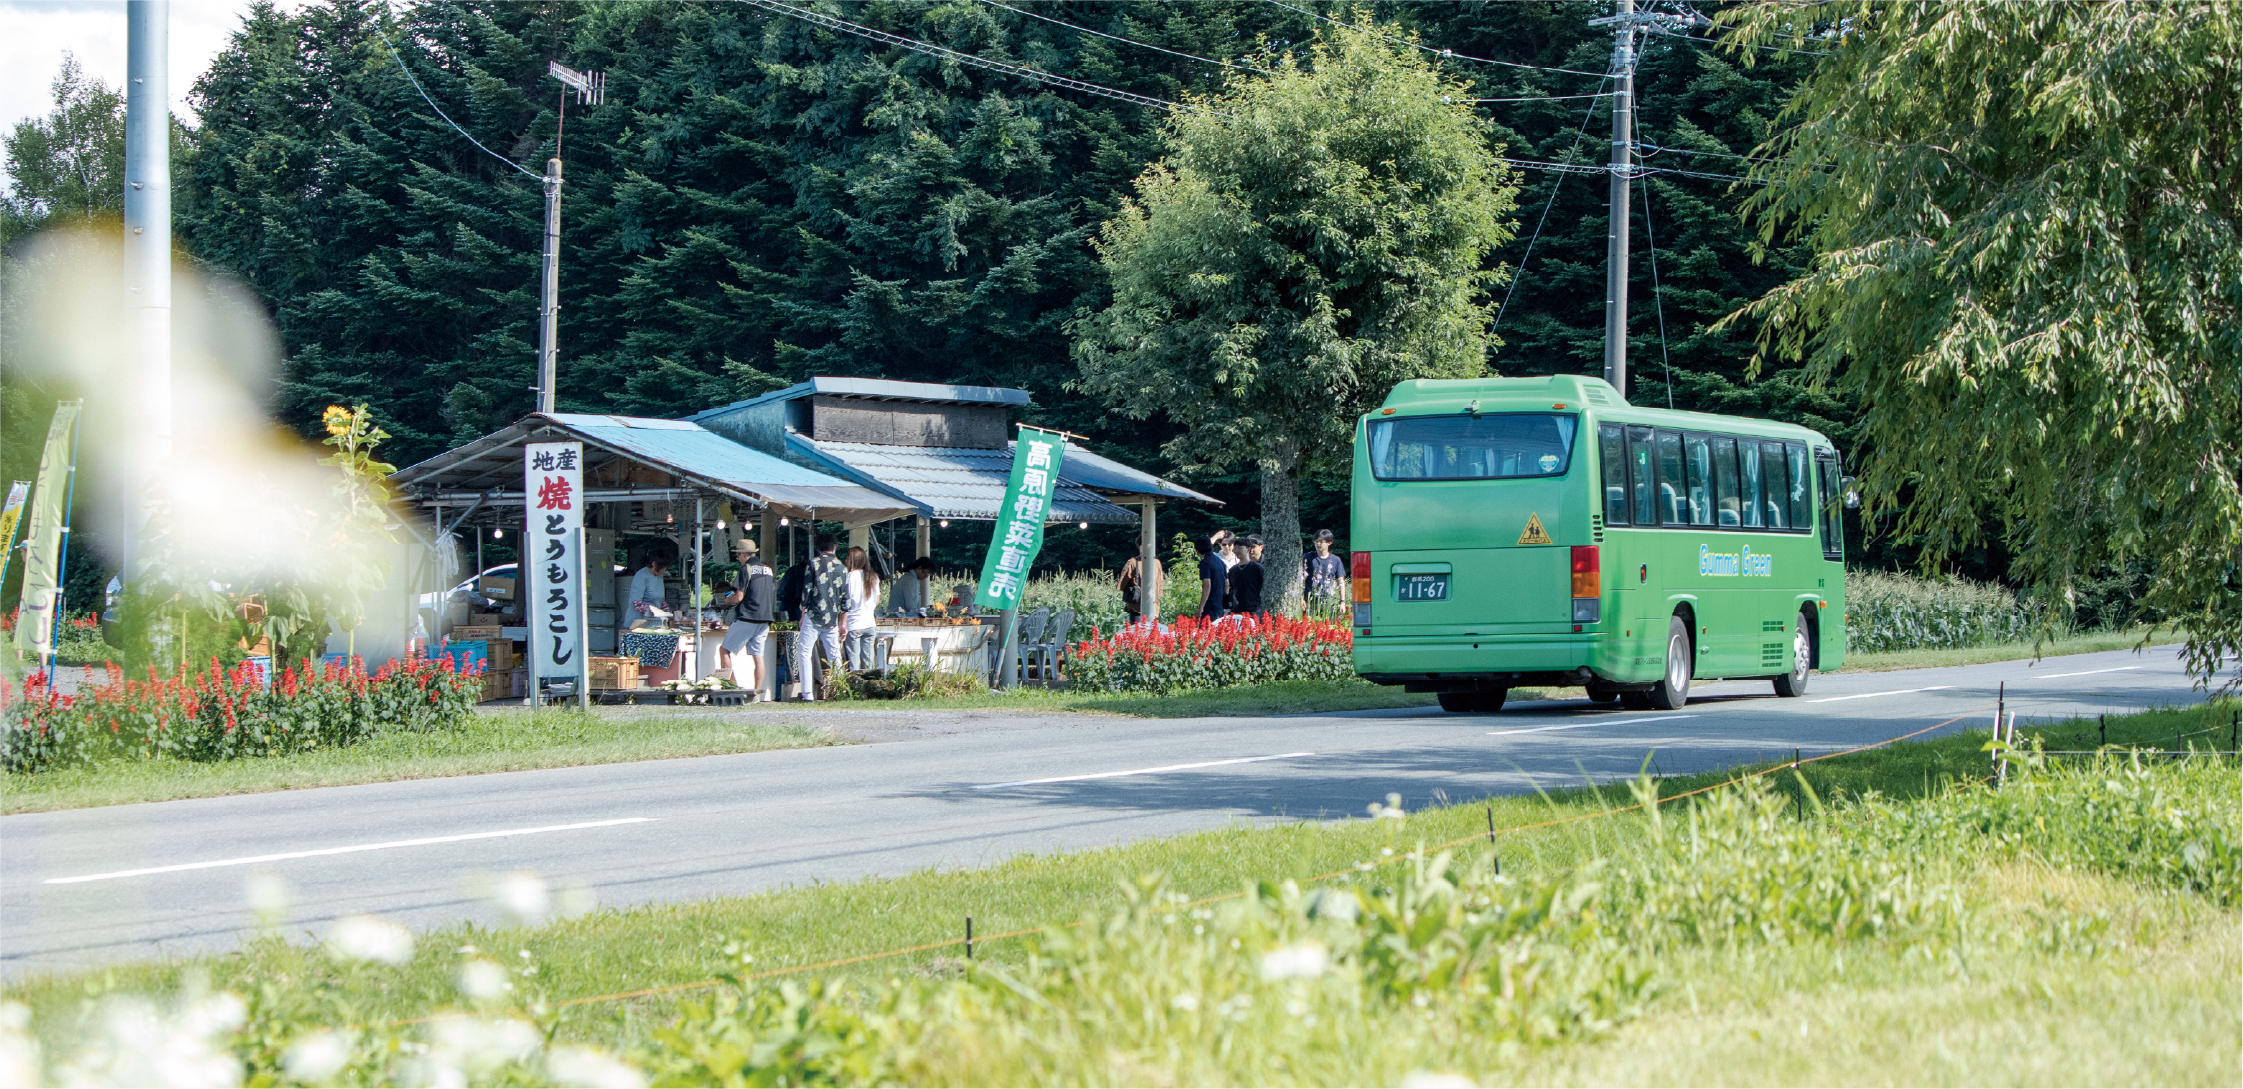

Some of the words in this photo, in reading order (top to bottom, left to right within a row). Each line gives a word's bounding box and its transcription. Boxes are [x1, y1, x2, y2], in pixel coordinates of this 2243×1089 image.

[532, 449, 577, 471] 地産
[988, 440, 1053, 601] 高原野菜直売
[1699, 544, 1739, 576] Gumma
[1742, 544, 1771, 577] Green
[1409, 582, 1445, 598] 11-67
